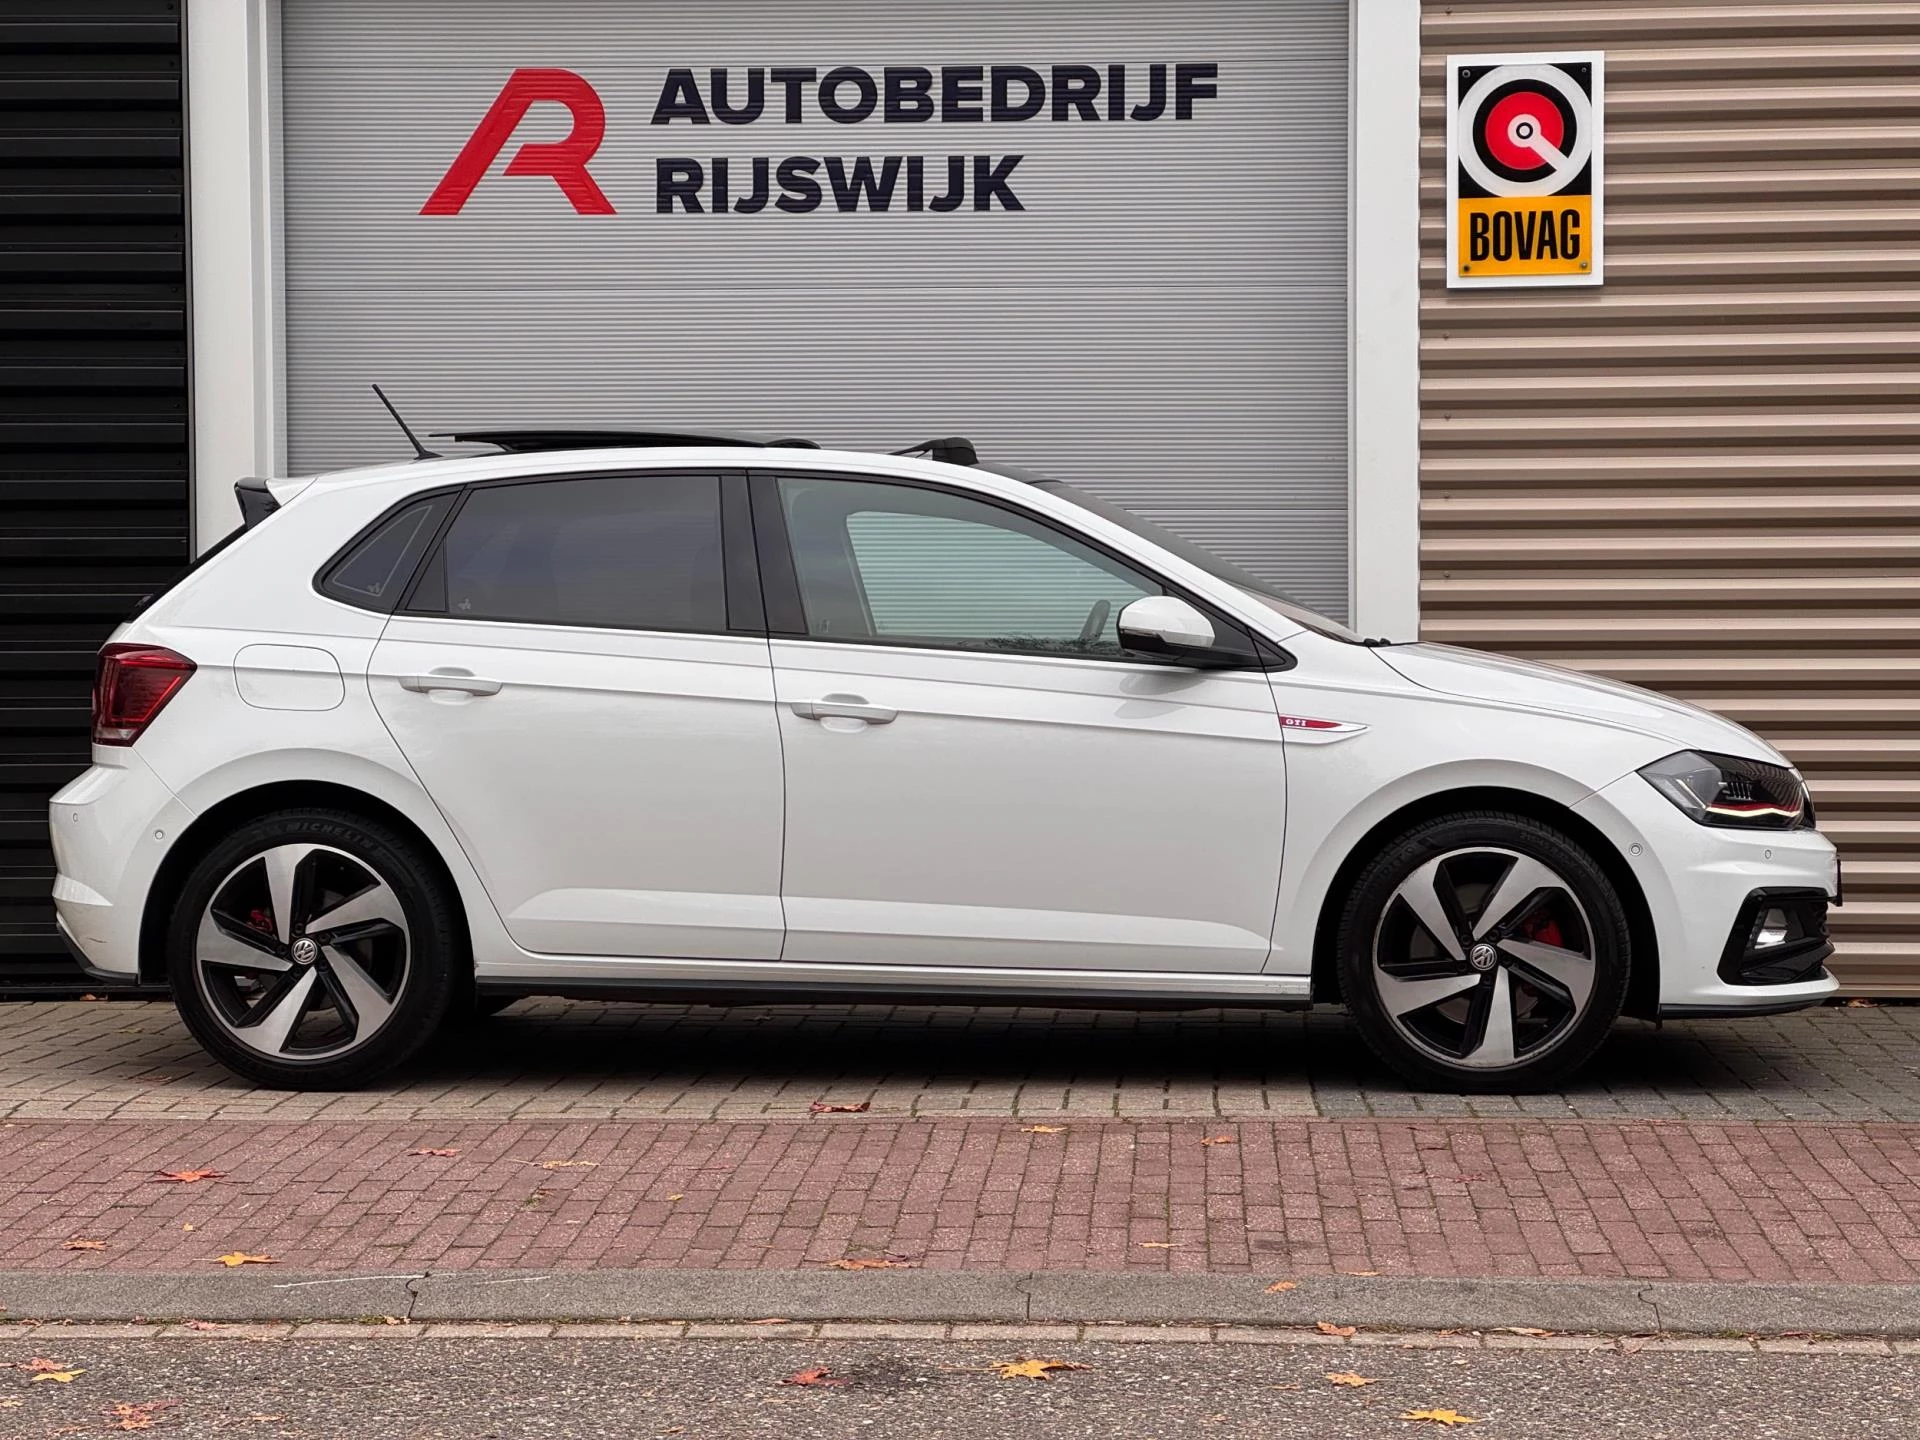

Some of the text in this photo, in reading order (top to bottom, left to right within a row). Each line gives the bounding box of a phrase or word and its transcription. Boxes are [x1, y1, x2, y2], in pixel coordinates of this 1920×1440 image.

[651, 63, 1218, 124] AUTOBEDRIJF
[655, 155, 1025, 214] RIJSWIJK
[1469, 208, 1581, 262] BOVAG
[286, 822, 375, 849] MICHELIN
